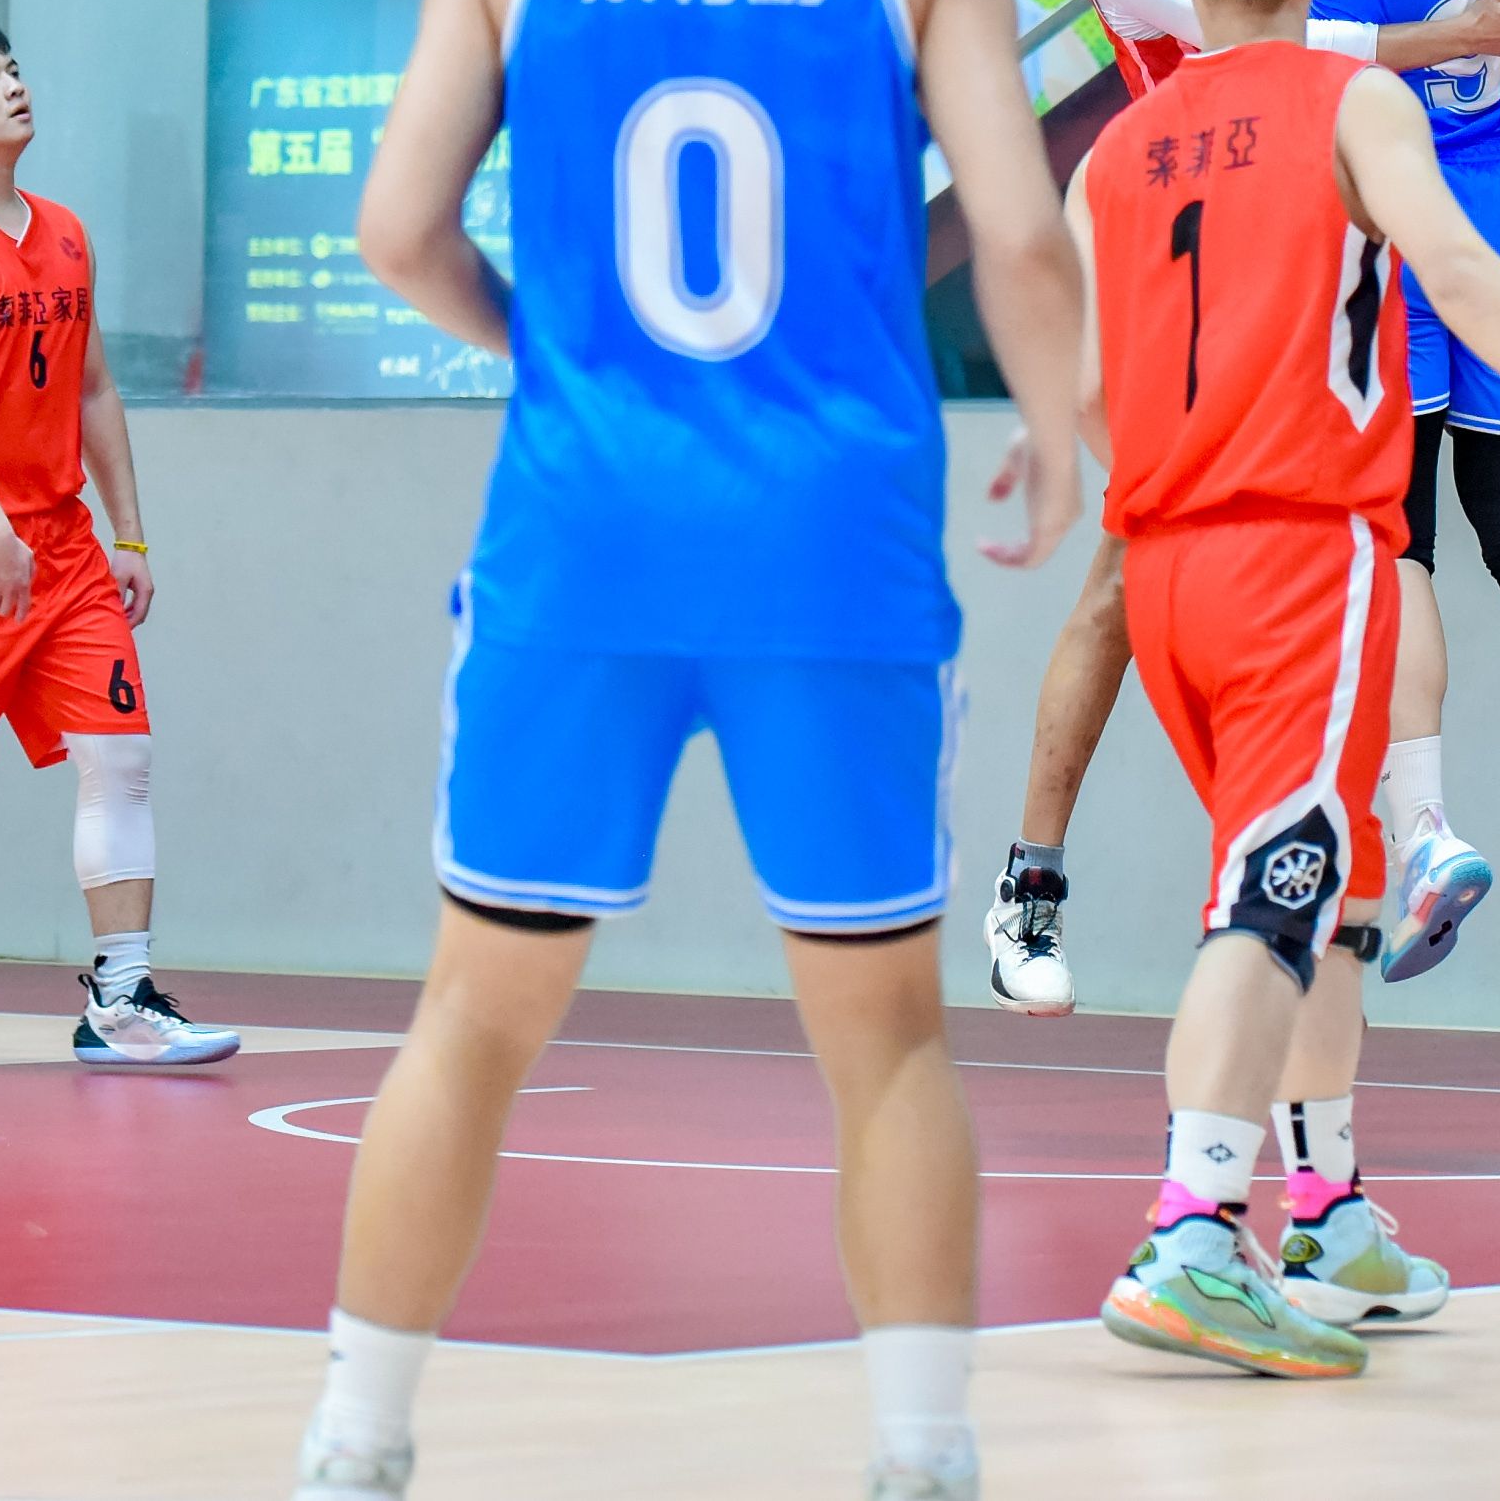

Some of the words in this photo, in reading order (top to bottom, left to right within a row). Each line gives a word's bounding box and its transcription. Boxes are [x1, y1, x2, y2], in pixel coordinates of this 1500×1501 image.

[613, 75, 785, 363] 0
[29, 329, 48, 390] 6
[1170, 199, 1204, 414] 1
[107, 659, 137, 714] 6
